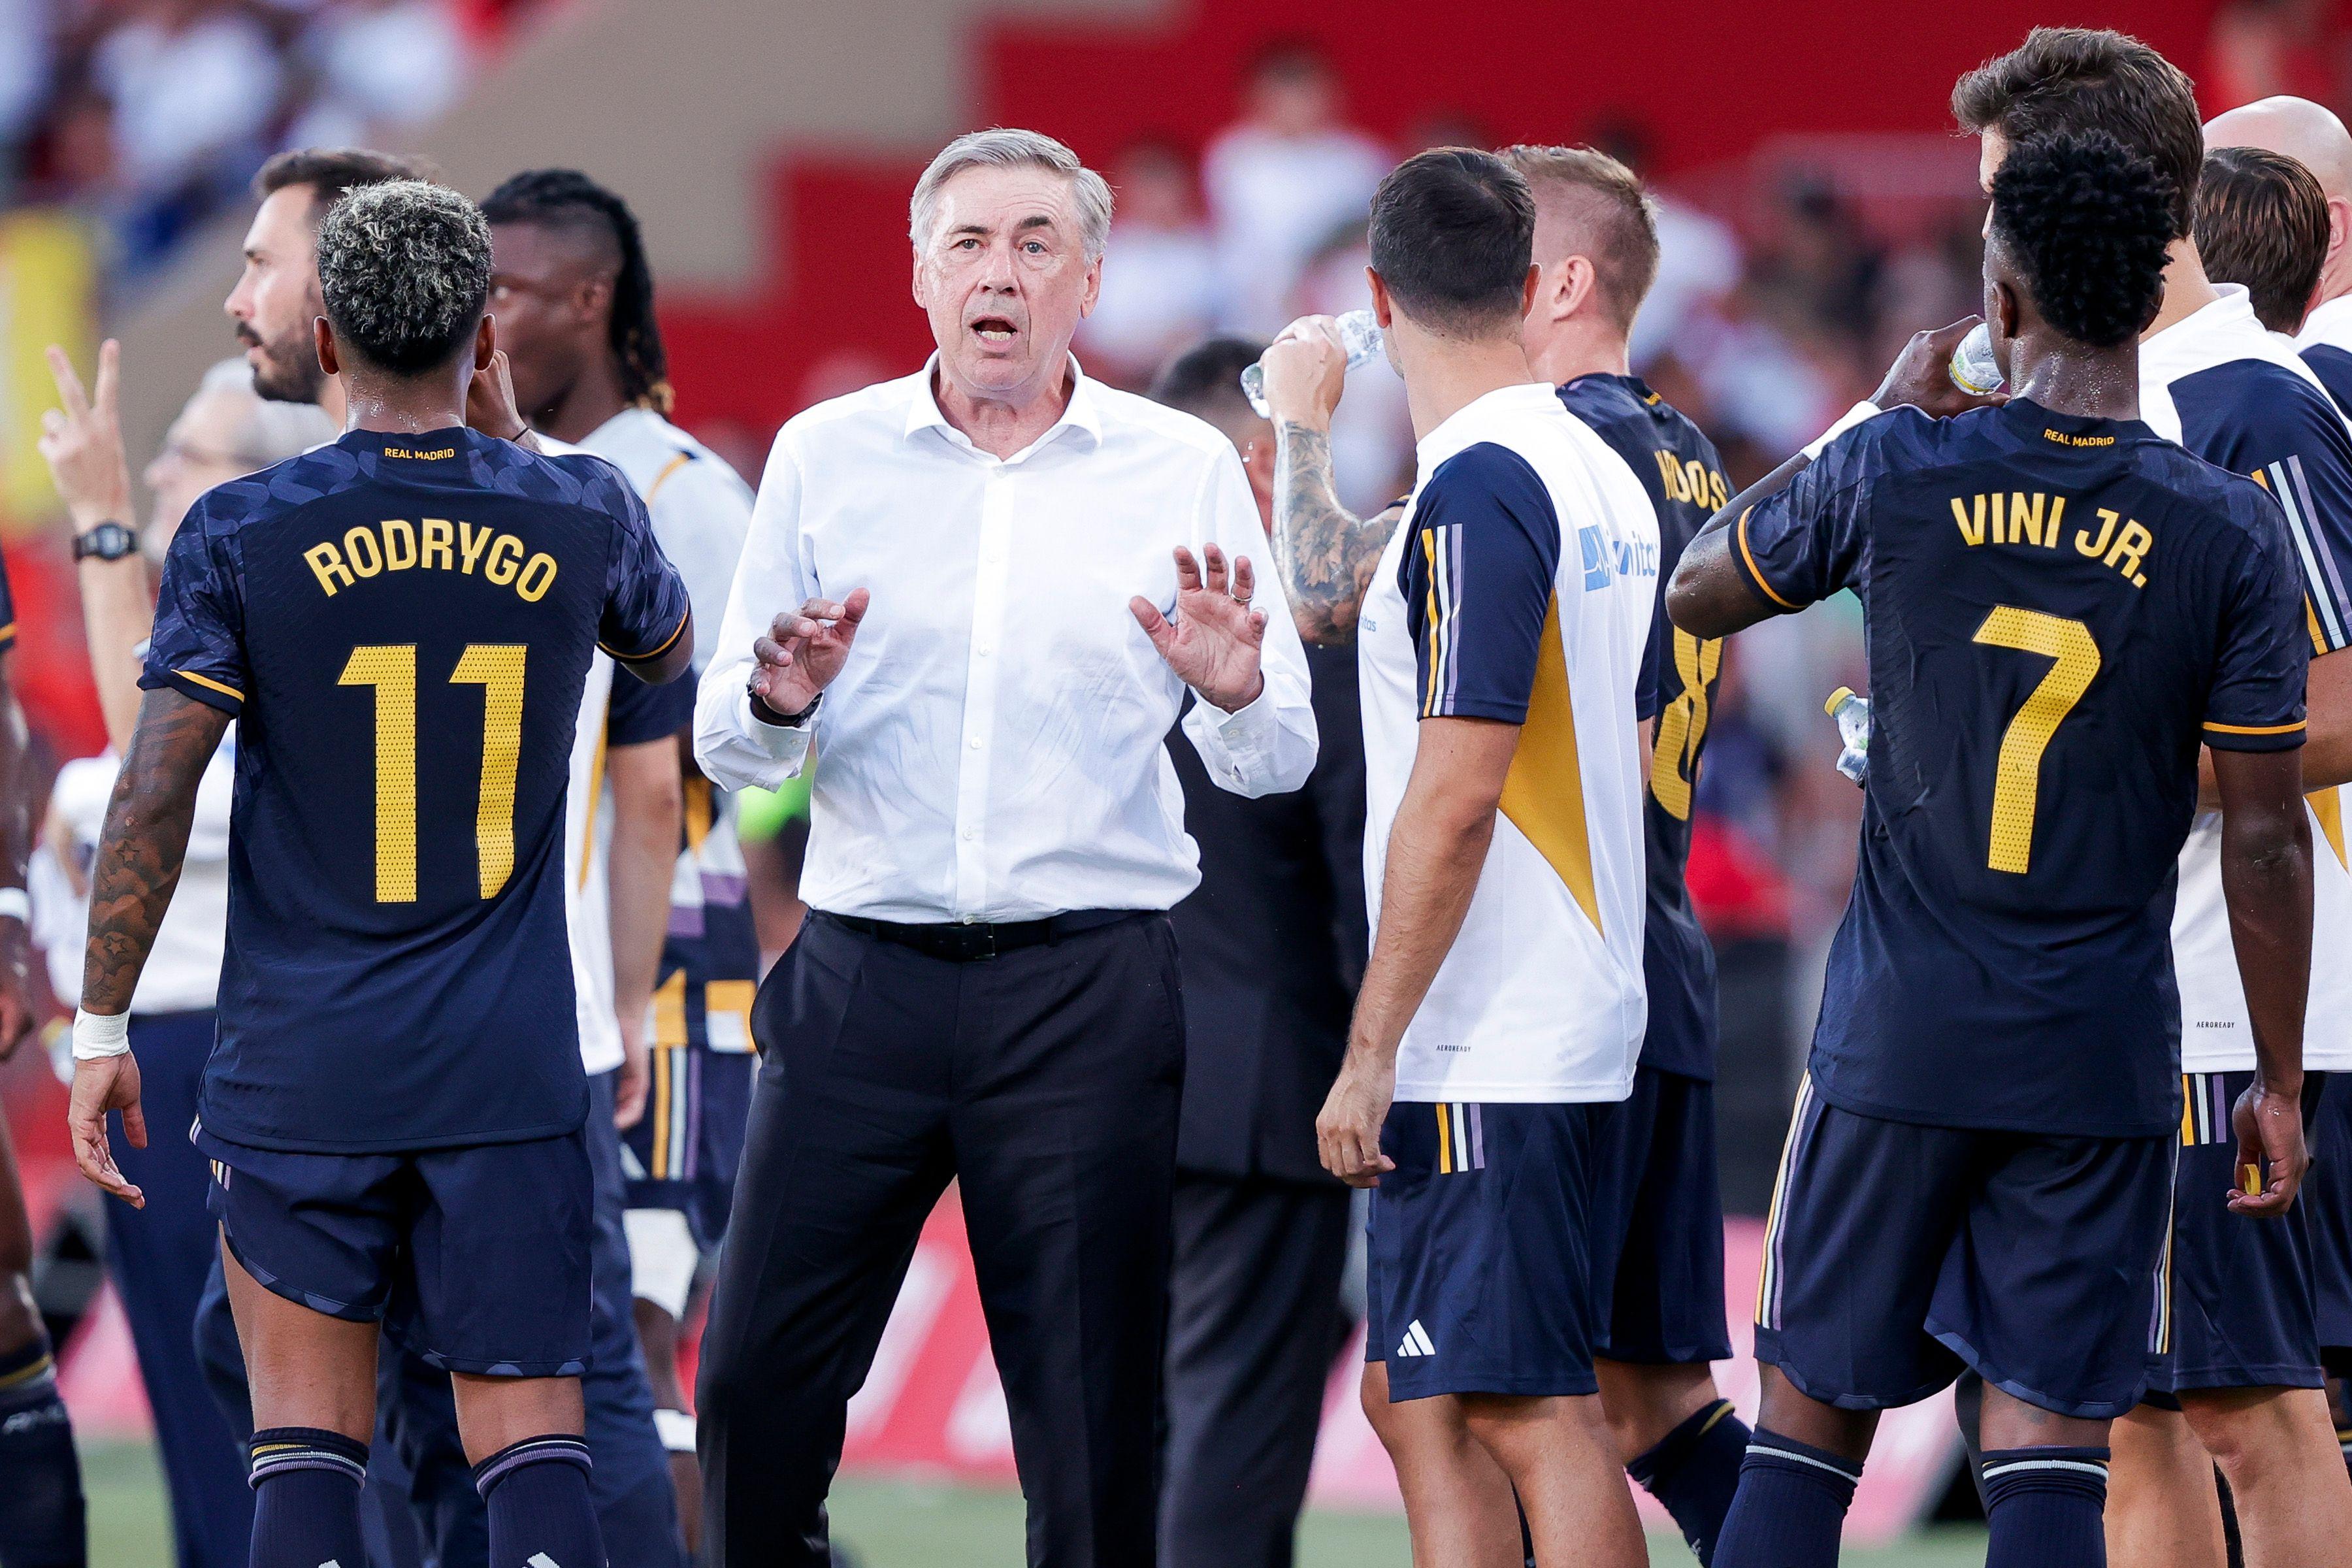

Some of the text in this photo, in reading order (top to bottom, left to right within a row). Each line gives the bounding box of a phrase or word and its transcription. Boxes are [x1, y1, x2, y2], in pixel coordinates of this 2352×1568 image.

[384, 448, 455, 461] REAL MADRID
[2044, 429, 2114, 447] REAL MADRID
[303, 517, 557, 603] RODRYGO
[1951, 492, 2152, 588] VINI JR.
[1650, 624, 1723, 822] 8
[1971, 603, 2101, 874] 7
[336, 643, 527, 904] 11
[1436, 1044, 1471, 1053] AEROREADY
